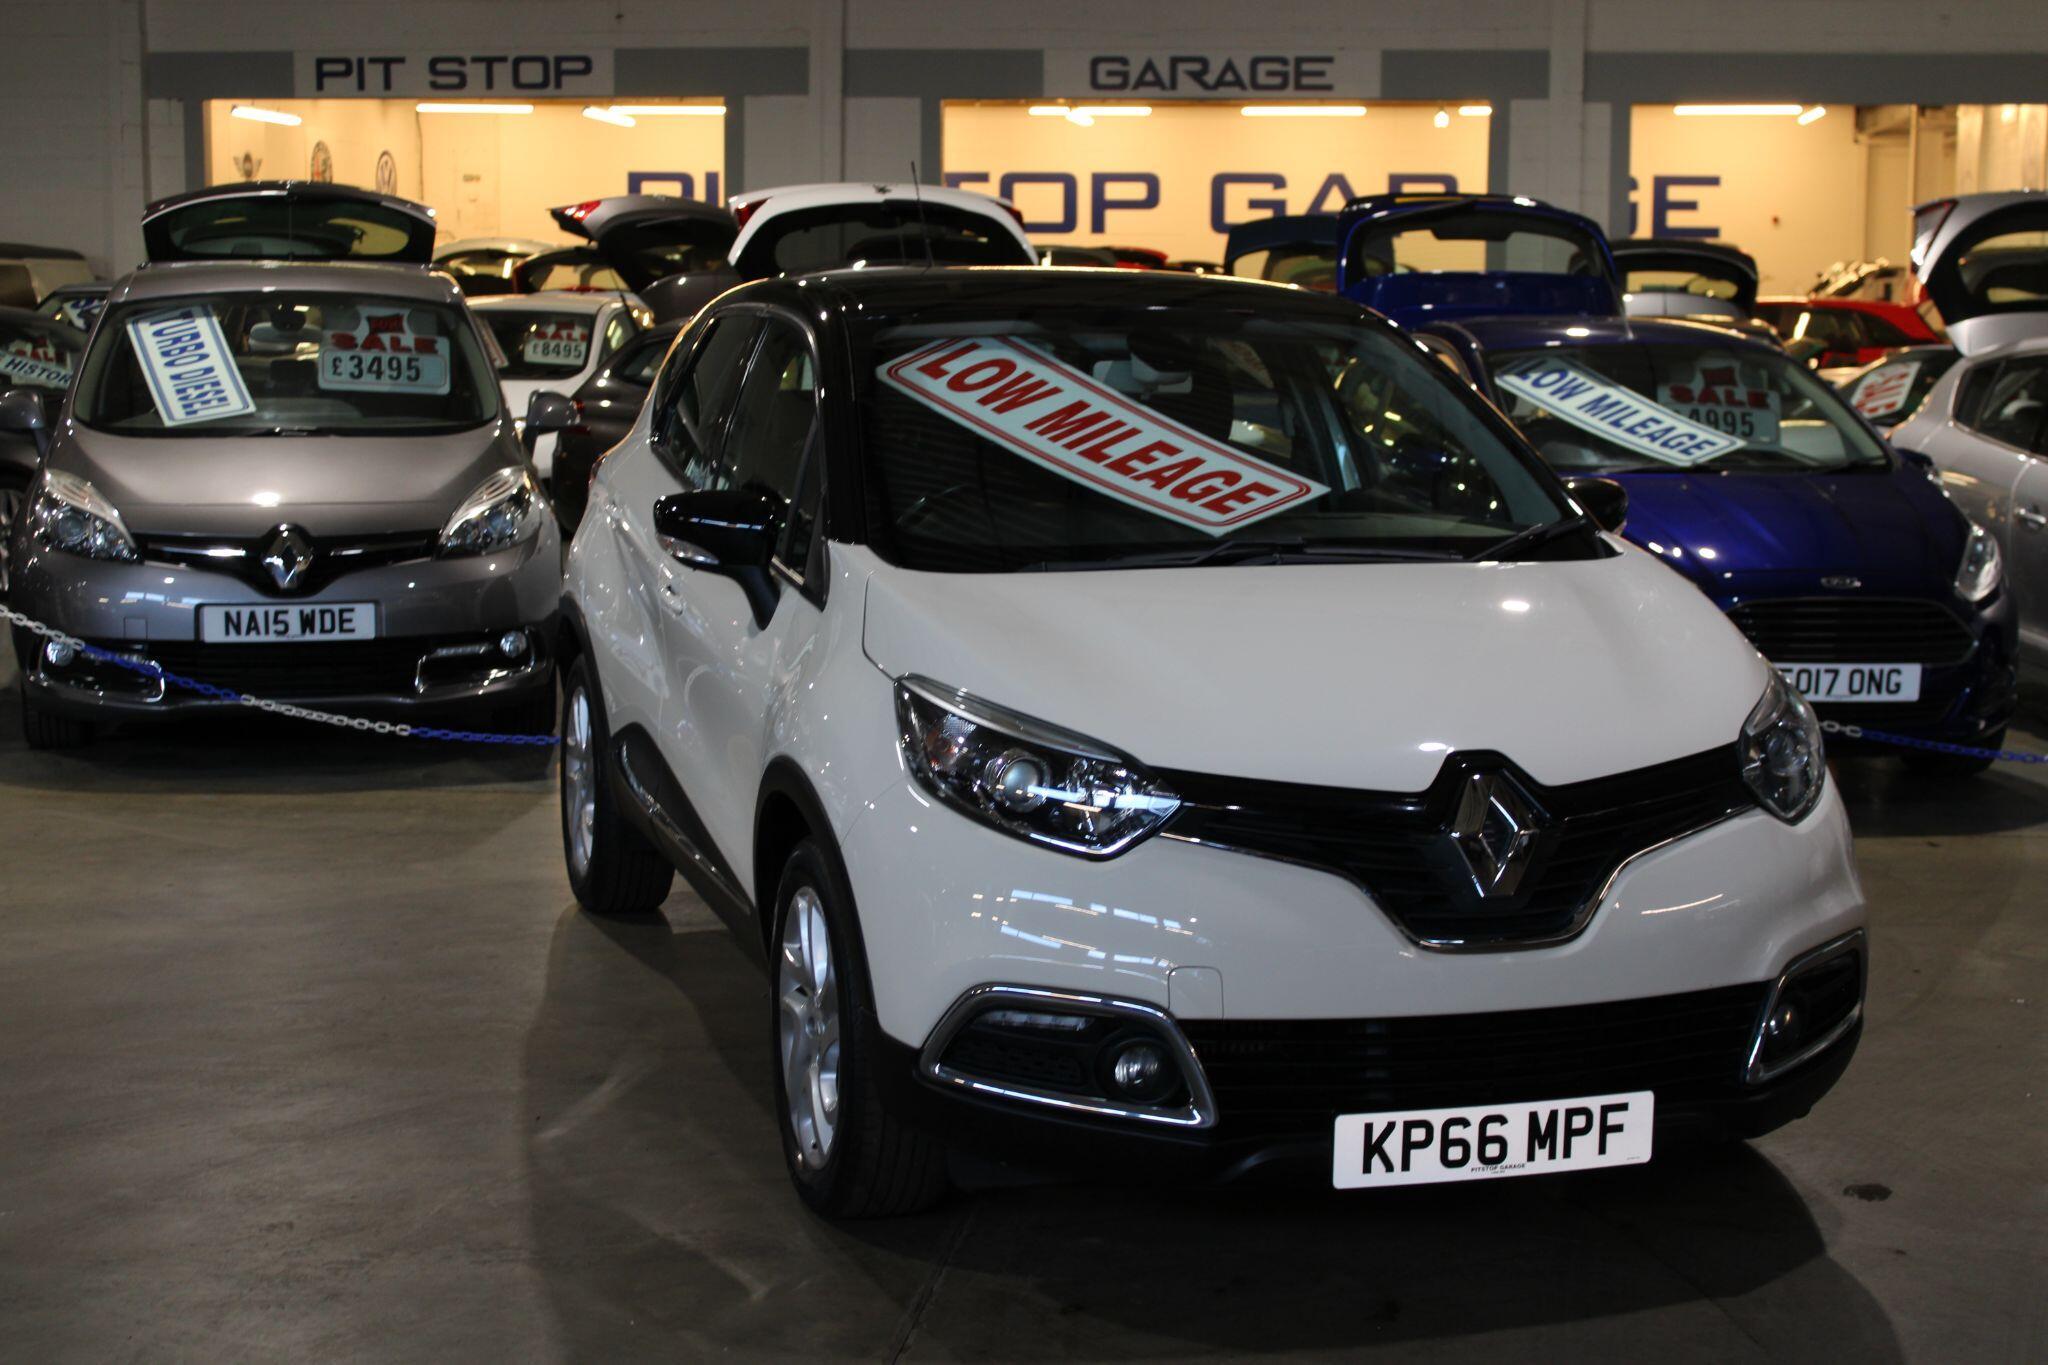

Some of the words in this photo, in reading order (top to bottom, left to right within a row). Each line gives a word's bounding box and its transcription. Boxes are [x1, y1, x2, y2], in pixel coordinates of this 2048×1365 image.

[315, 57, 405, 91] PIT
[428, 55, 593, 90] STOP
[1089, 56, 1334, 91] GARAGE
[149, 310, 210, 367] TURBO
[331, 332, 439, 354] SALE
[4, 357, 72, 384] HISTOR
[169, 366, 231, 416] DIESEL
[1520, 358, 1589, 401] LOW
[1586, 389, 1718, 458] MILEAGE
[917, 342, 1064, 414] LOW
[1023, 400, 1282, 516] MILEAGE
[1675, 408, 1754, 437] 4995
[224, 609, 290, 636] NA15
[299, 608, 356, 634] WDE
[1849, 668, 1902, 695] ONG
[1362, 1113, 1509, 1175] KP66
[1527, 1102, 1630, 1163] MPF
